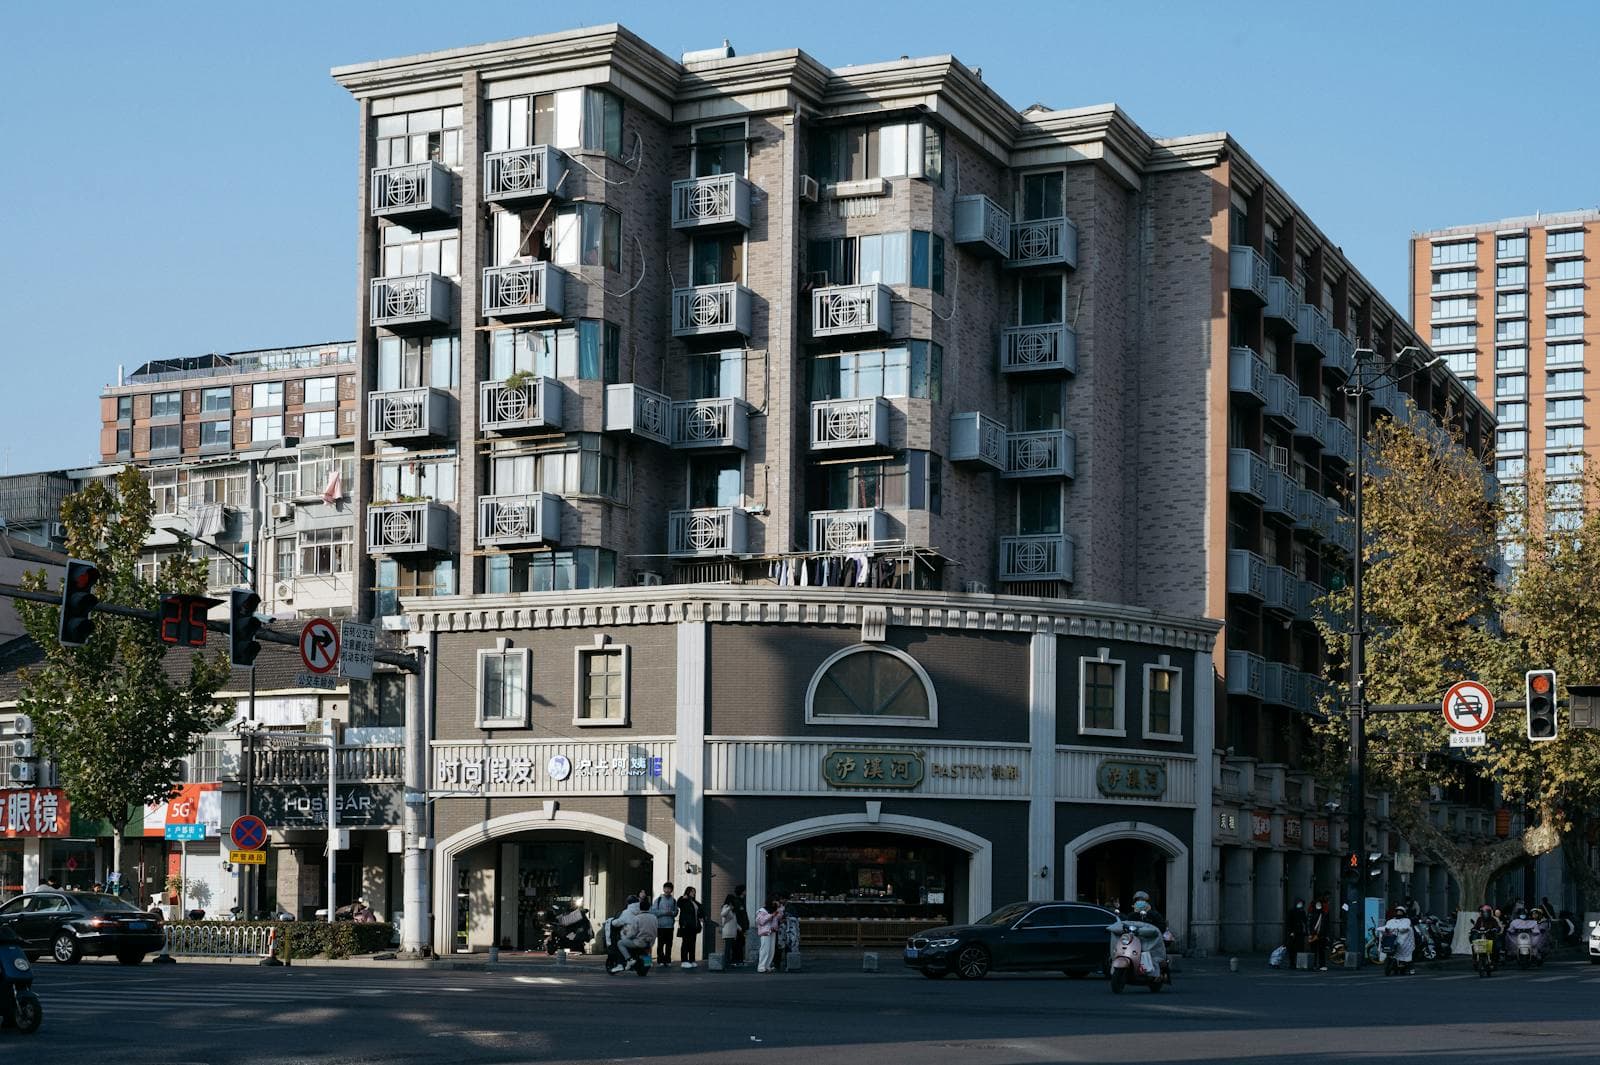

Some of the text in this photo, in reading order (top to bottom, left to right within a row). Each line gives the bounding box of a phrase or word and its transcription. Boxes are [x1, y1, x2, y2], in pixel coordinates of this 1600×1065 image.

[161, 599, 207, 645] 25
[341, 663, 347, 674] 人
[439, 757, 535, 784] 时尚假发
[575, 757, 647, 770] 沪上阿姨
[931, 763, 985, 780] PASTRY
